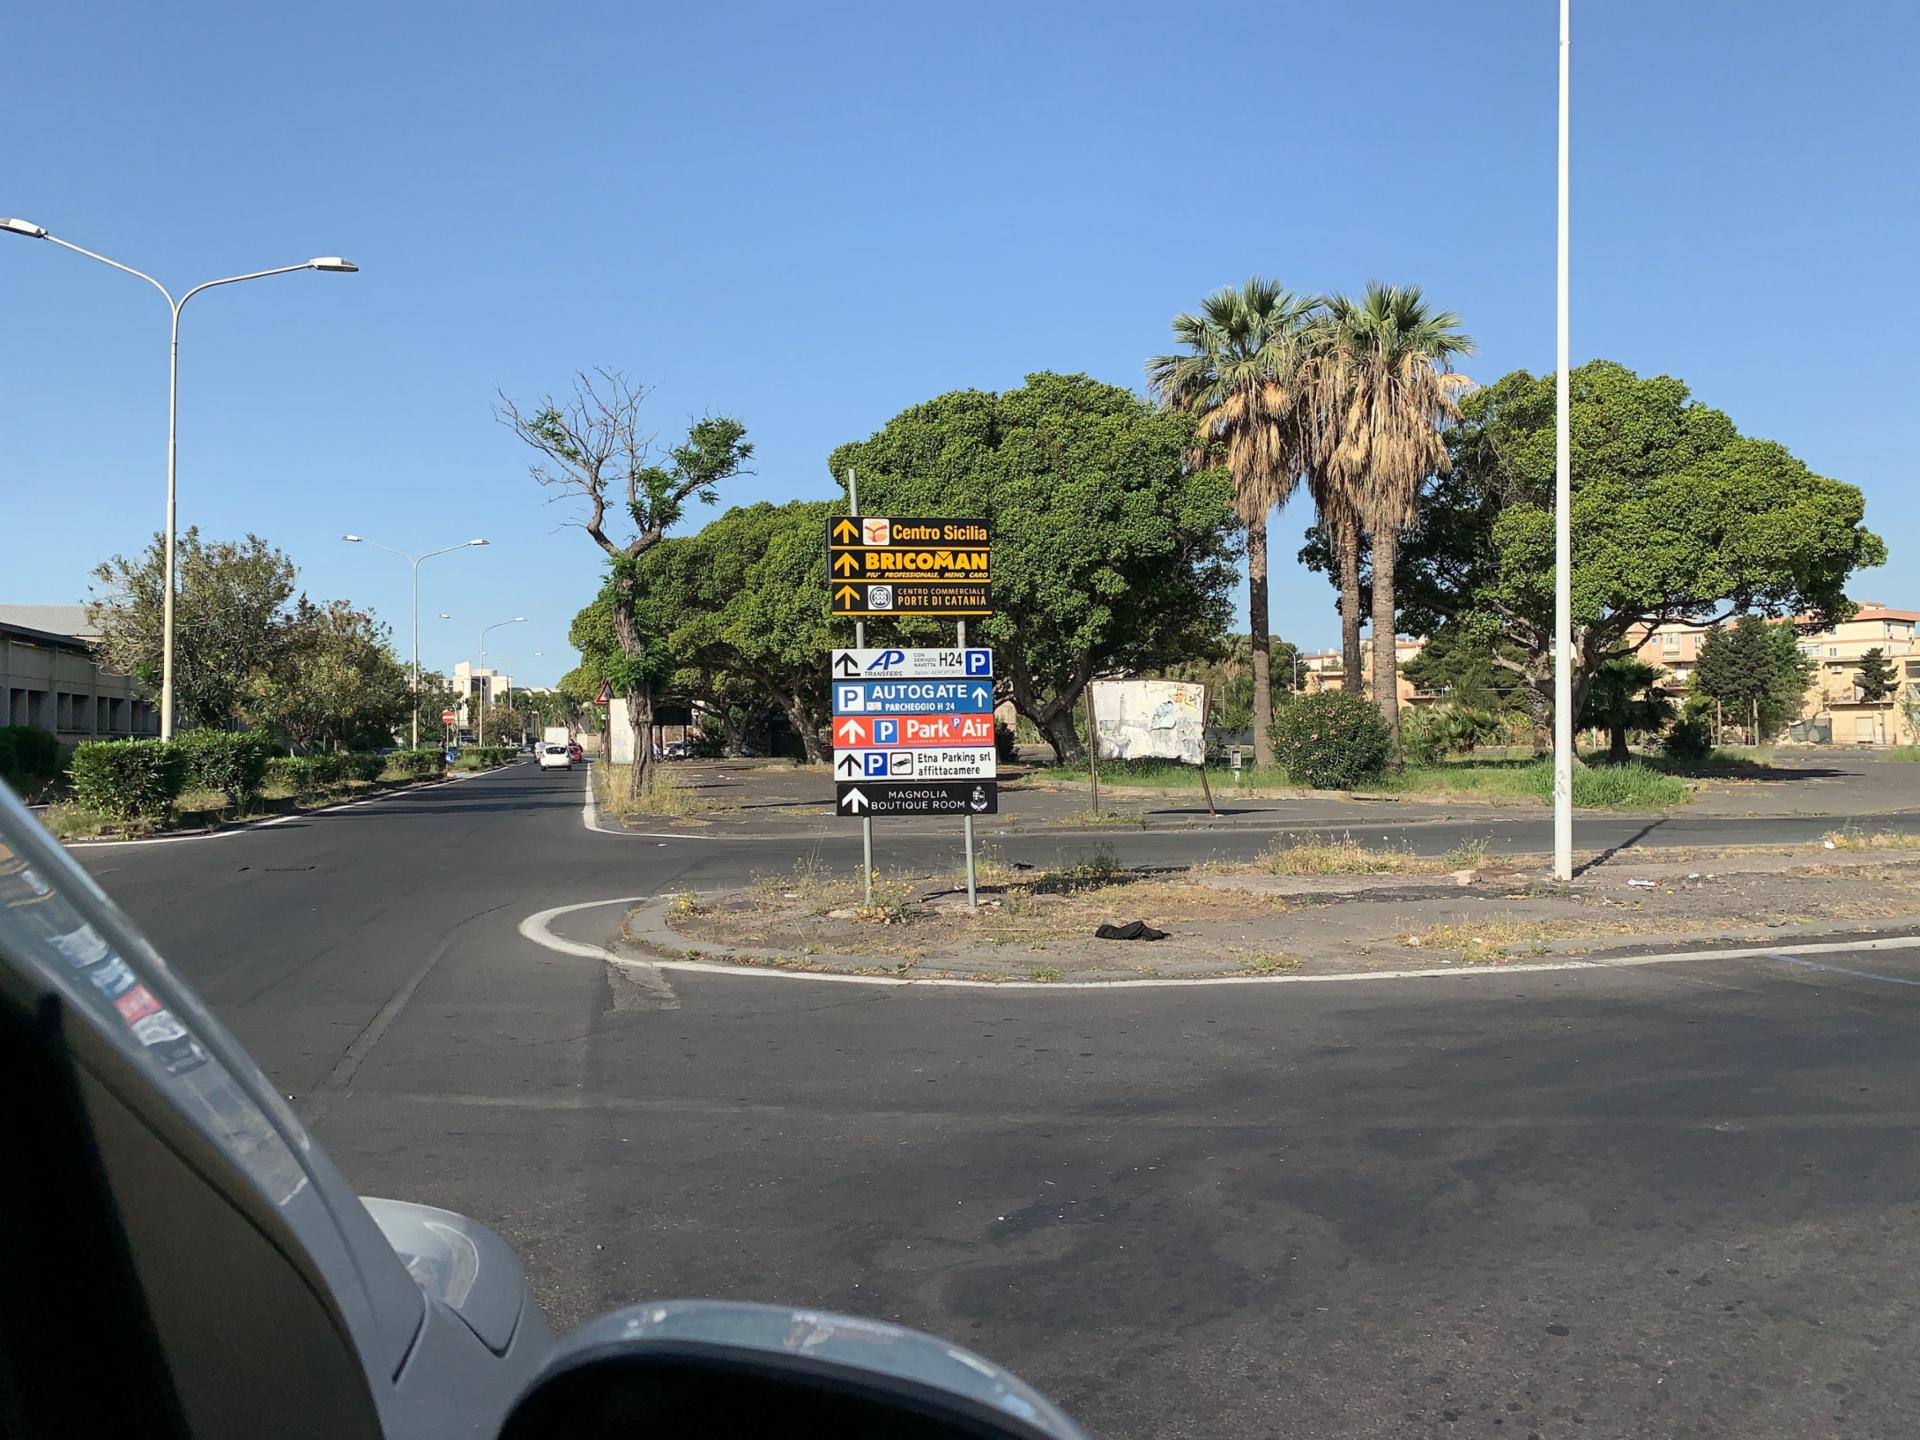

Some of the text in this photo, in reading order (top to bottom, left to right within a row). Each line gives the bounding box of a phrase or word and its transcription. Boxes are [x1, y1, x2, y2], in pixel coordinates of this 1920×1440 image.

[893, 524, 987, 540] Centro Sicilia
[865, 551, 988, 570] BRICOMAN
[898, 596, 986, 606] PORTE DI CATANIA
[939, 652, 963, 667] H24
[971, 654, 986, 672] P
[844, 689, 858, 708] P
[872, 684, 968, 699] AUTOGATE
[886, 702, 936, 711] PARCHEGGIO
[946, 702, 955, 711] 24
[880, 722, 894, 741] P
[906, 720, 950, 738] Park
[962, 718, 990, 737] Air
[868, 754, 883, 774] P
[918, 752, 991, 764] Etna Parking srl
[918, 766, 980, 776] affittacamere
[888, 790, 948, 799] MAGNOLIA
[871, 800, 966, 810] BOUTIQUE ROOM
